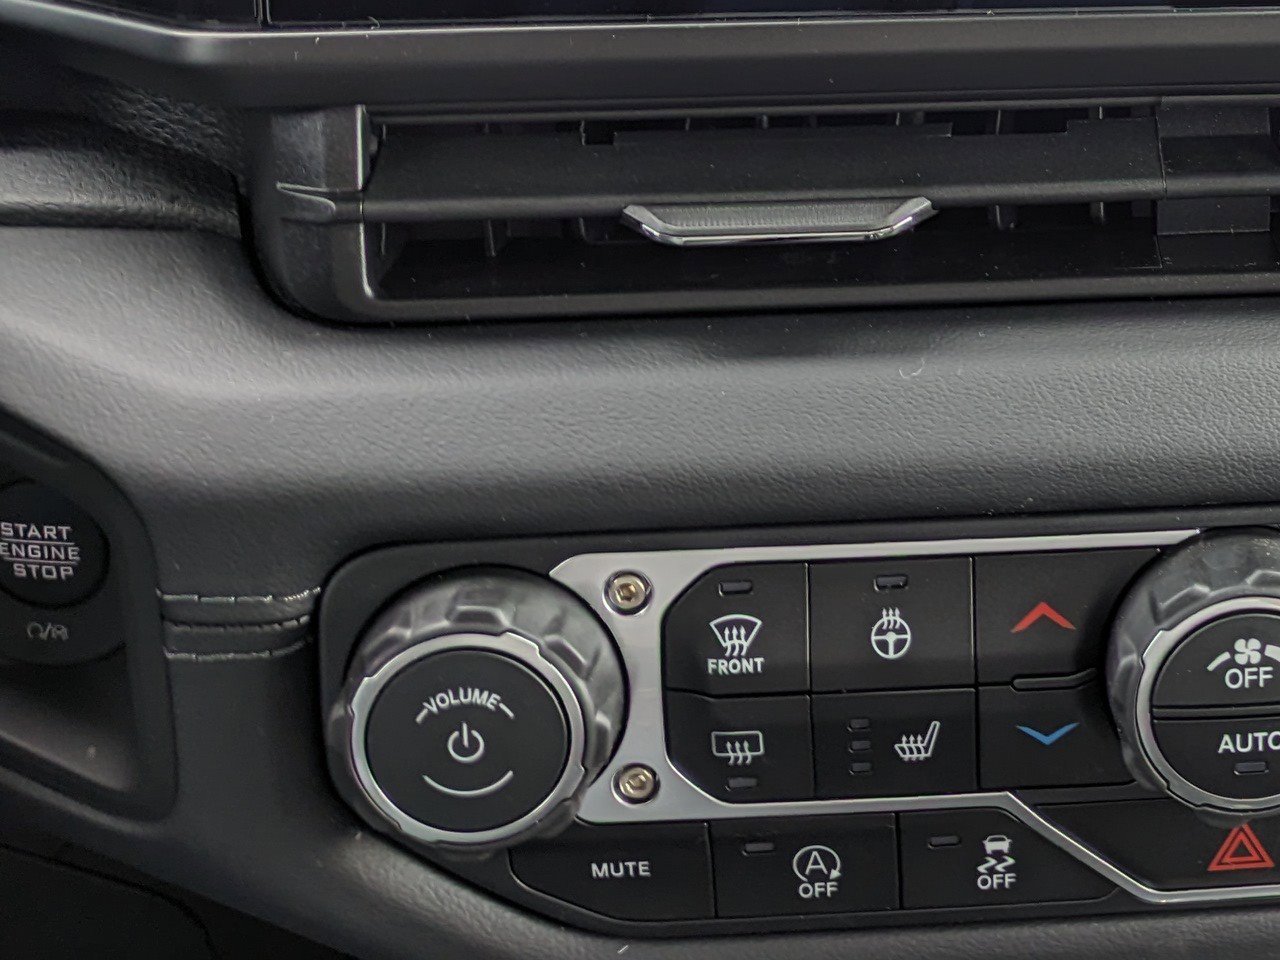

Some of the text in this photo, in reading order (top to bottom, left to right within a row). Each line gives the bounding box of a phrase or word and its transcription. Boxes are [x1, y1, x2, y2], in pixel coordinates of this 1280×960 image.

[0, 522, 73, 540] START
[0, 542, 81, 561] ENGINE
[13, 563, 75, 580] STOP
[707, 657, 765, 675] FRONT
[1224, 666, 1274, 690] OFF
[422, 687, 503, 715] VOLUME
[591, 860, 651, 879] MUTE
[798, 881, 839, 899] OFF
[977, 874, 1017, 890] OFF
